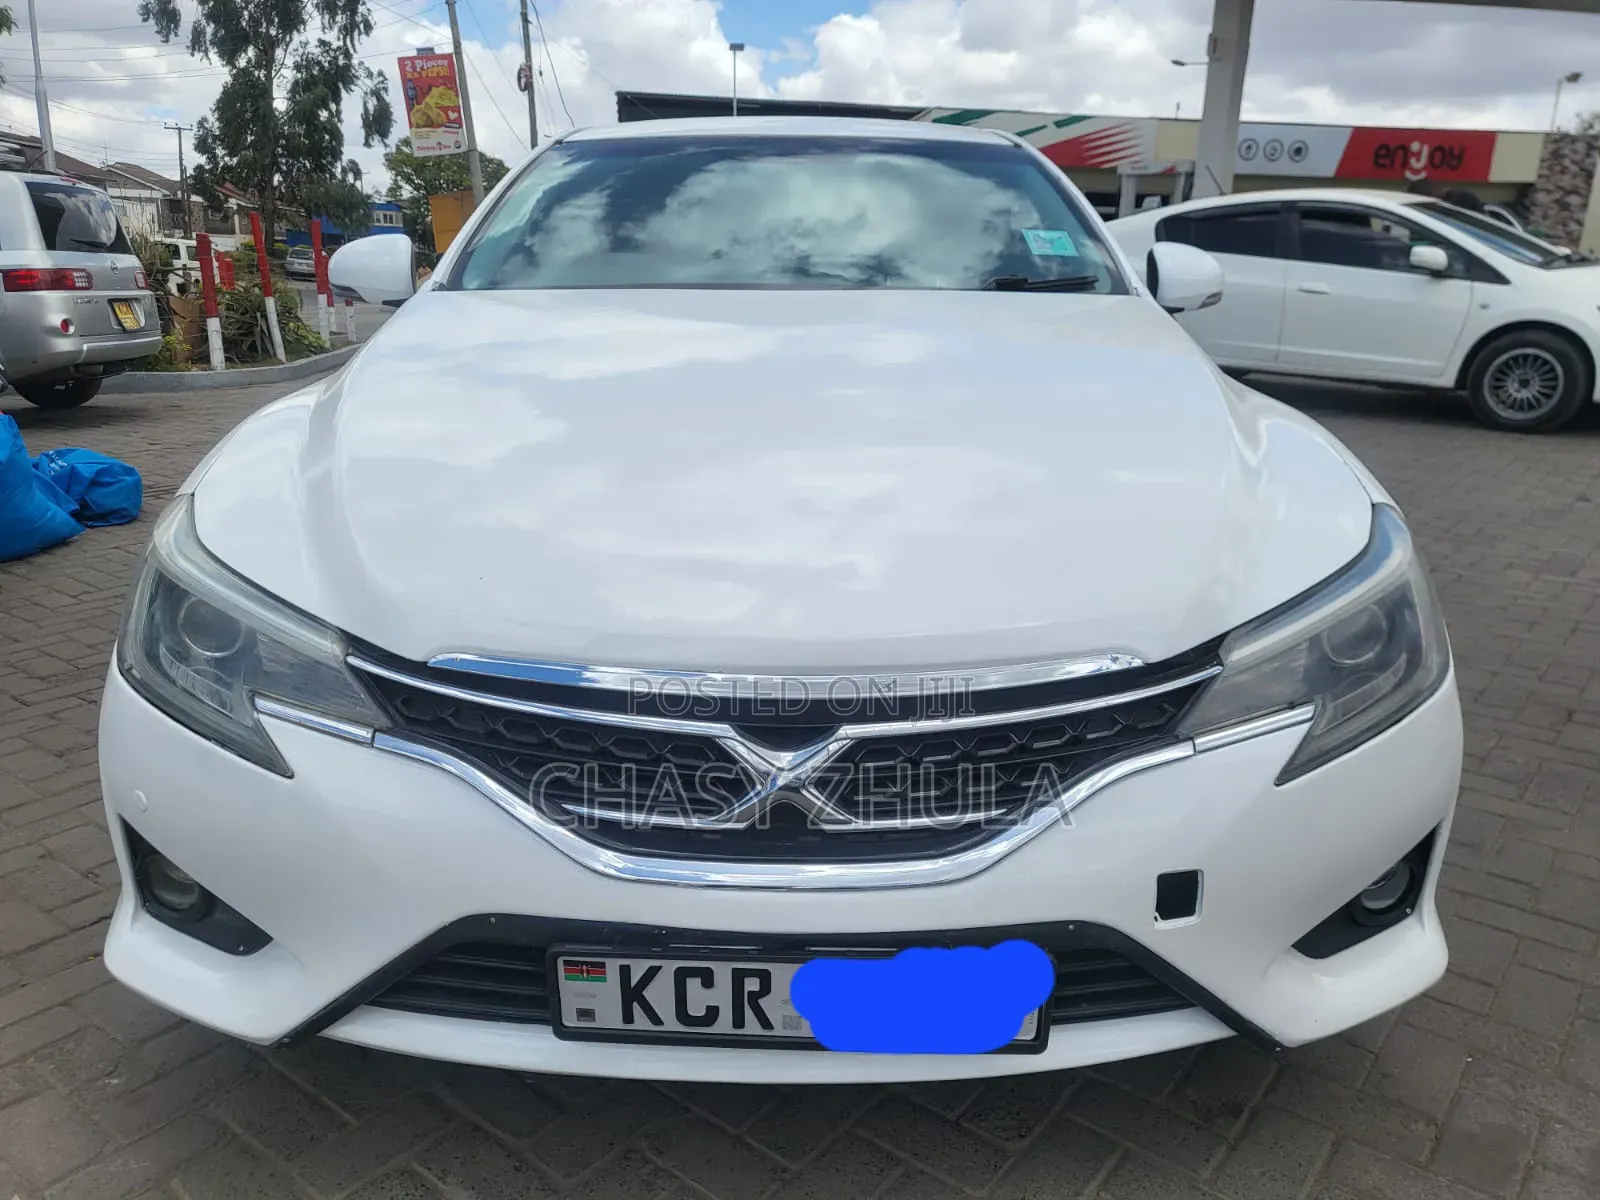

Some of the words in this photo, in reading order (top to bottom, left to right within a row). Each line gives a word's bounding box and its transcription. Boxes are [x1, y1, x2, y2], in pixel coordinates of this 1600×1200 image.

[404, 60, 413, 72] 2
[1373, 141, 1466, 173] enjoy
[619, 964, 775, 1030] KCR
